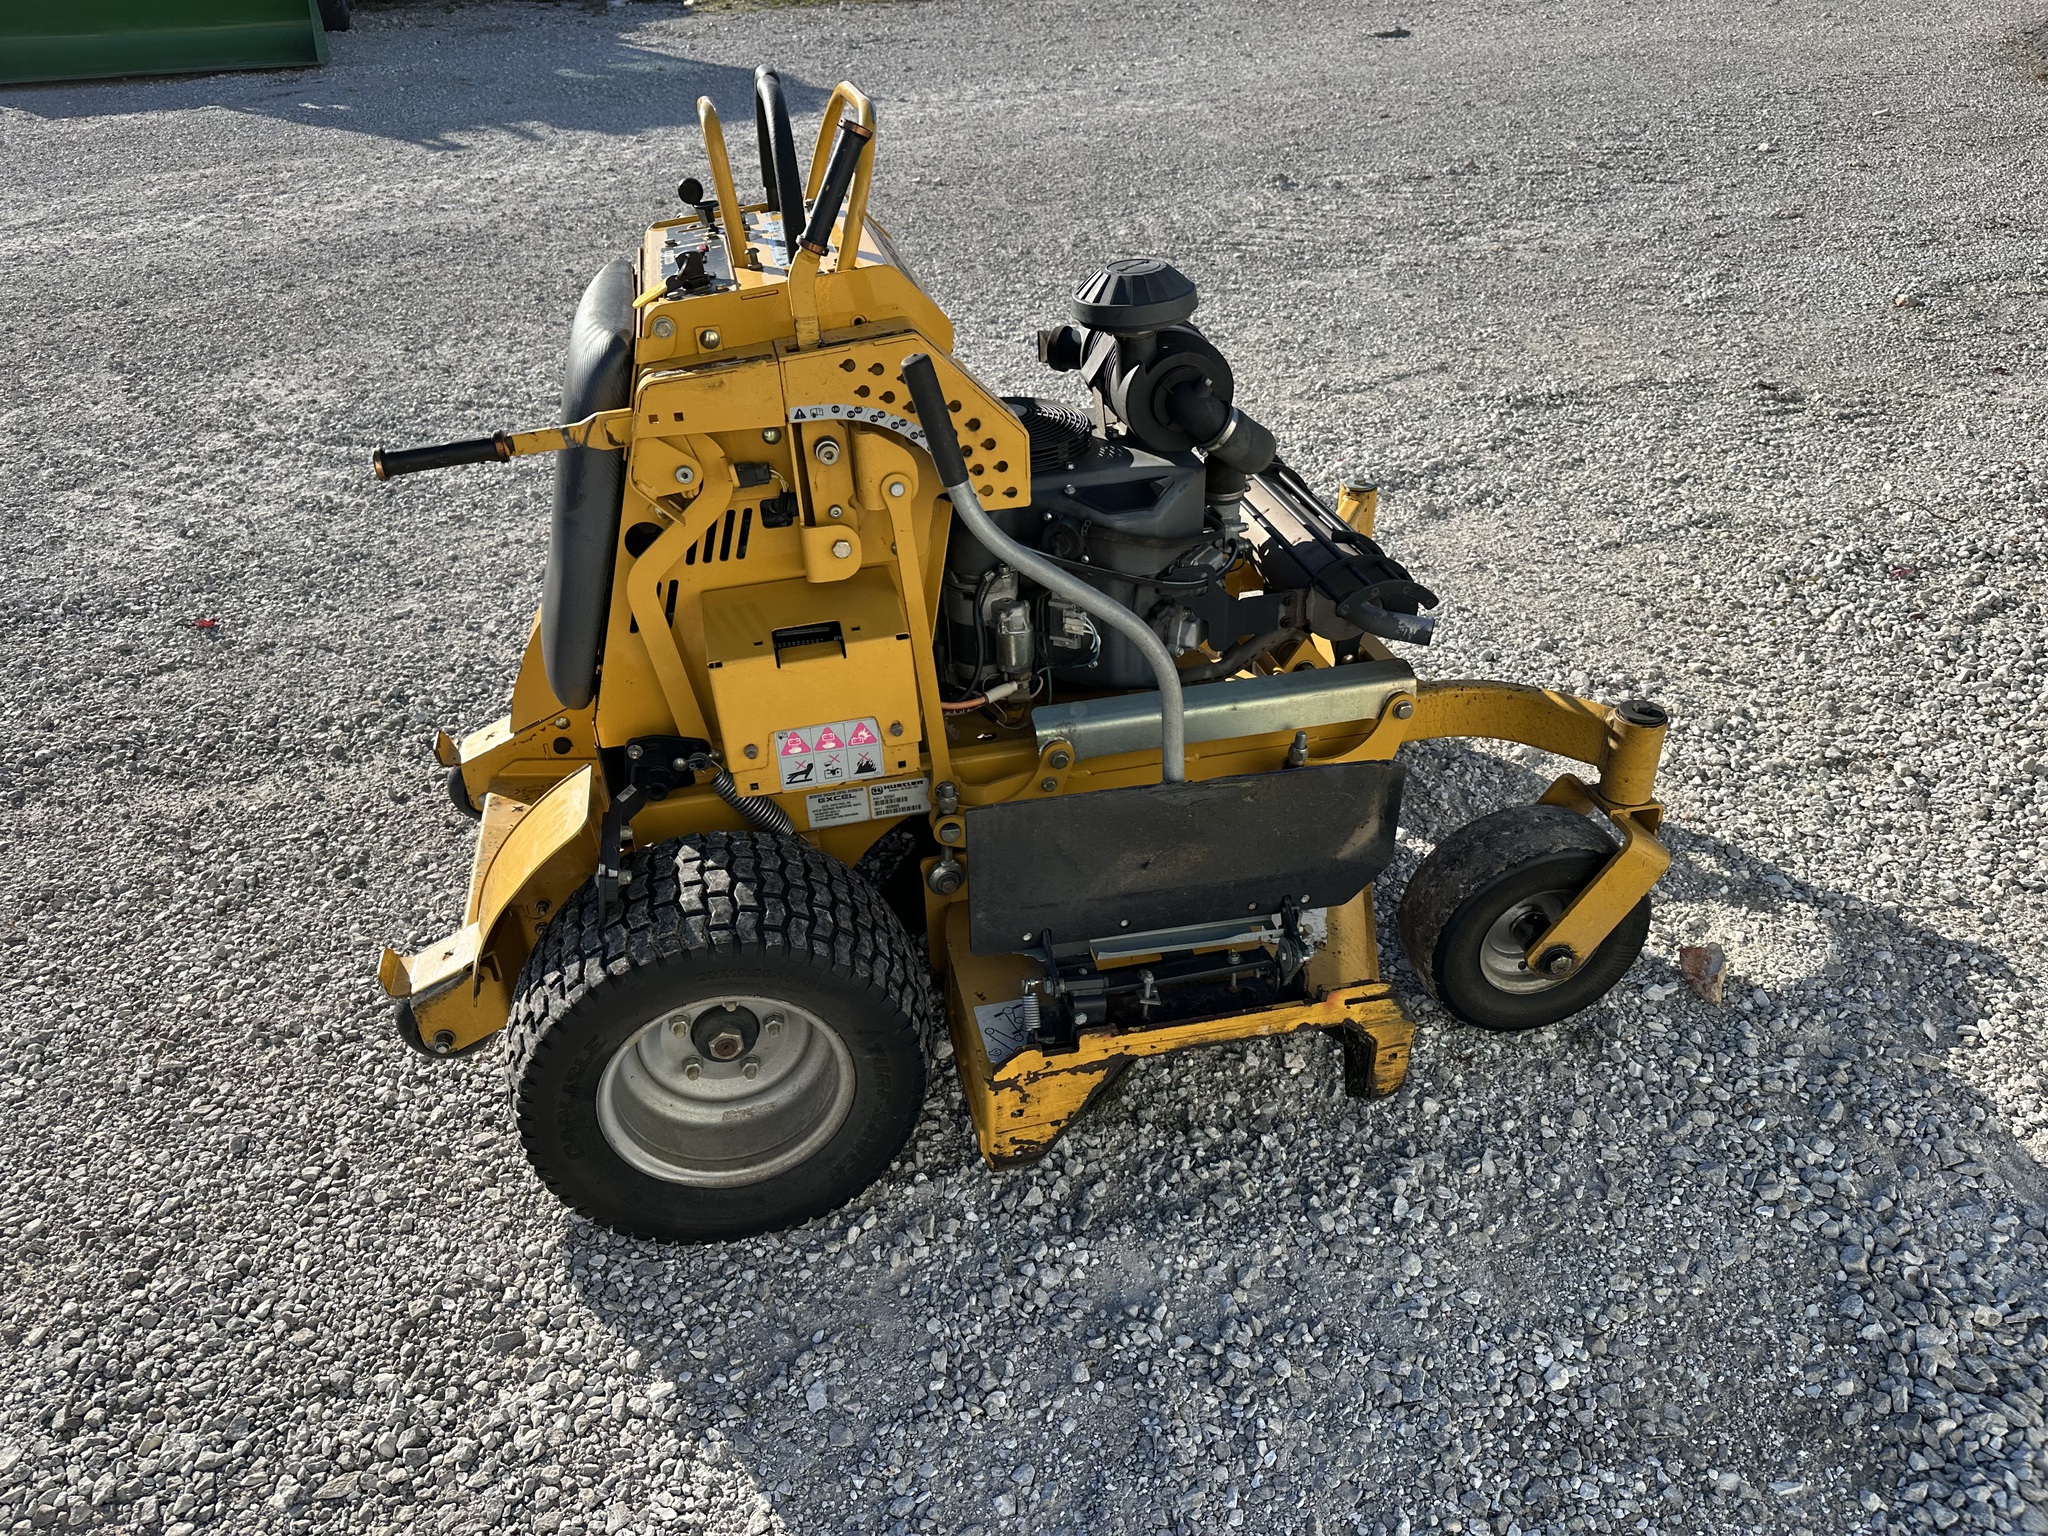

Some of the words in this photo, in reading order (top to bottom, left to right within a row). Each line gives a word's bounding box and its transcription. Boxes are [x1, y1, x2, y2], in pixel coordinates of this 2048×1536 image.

[884, 780, 924, 790] HUSTLER
[818, 794, 857, 803] EXCEL
[557, 1034, 608, 1159] CARLISLE
